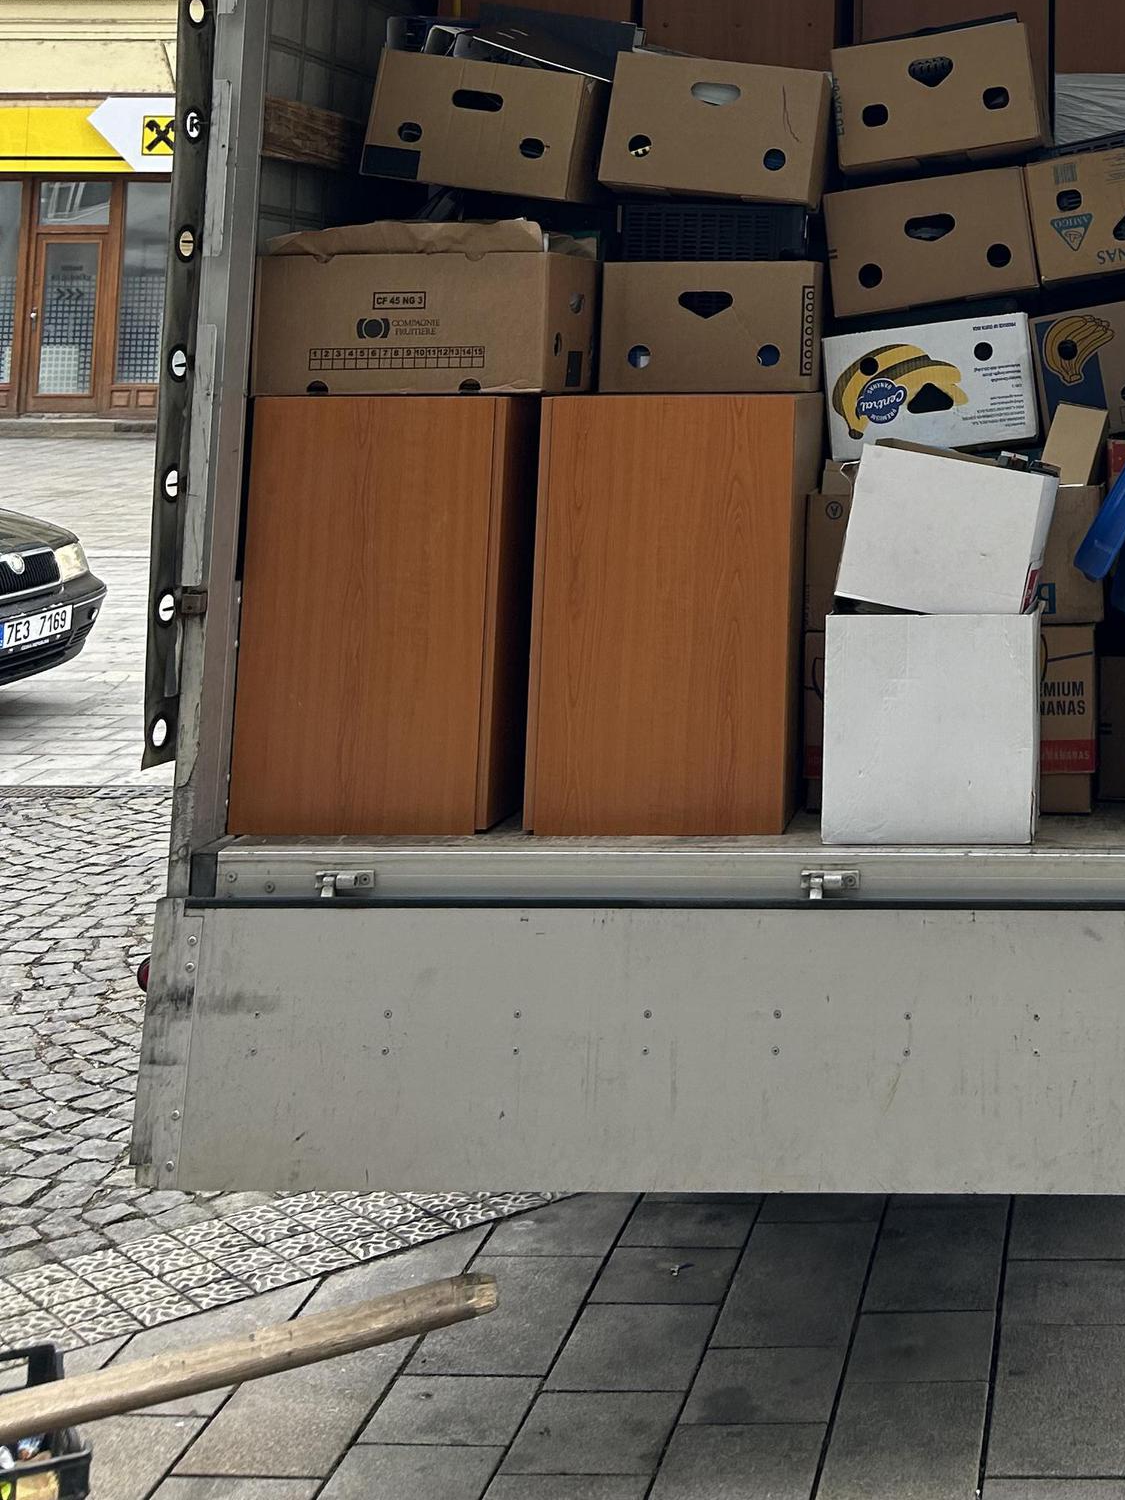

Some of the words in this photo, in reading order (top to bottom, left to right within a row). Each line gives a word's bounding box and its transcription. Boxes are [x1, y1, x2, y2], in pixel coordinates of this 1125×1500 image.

[1053, 214, 1091, 229] AMIGO
[376, 297, 387, 305] CF
[389, 296, 400, 305] 45
[402, 296, 416, 305] NG
[417, 296, 423, 305] 3
[391, 318, 440, 328] COMPAGNIE
[865, 381, 893, 395] BANANAS
[859, 388, 905, 412] Central
[869, 407, 897, 423] PREMIUM
[6, 620, 30, 645] 7E3
[1040, 681, 1084, 697] MIUM
[1040, 700, 1086, 716] NANAS
